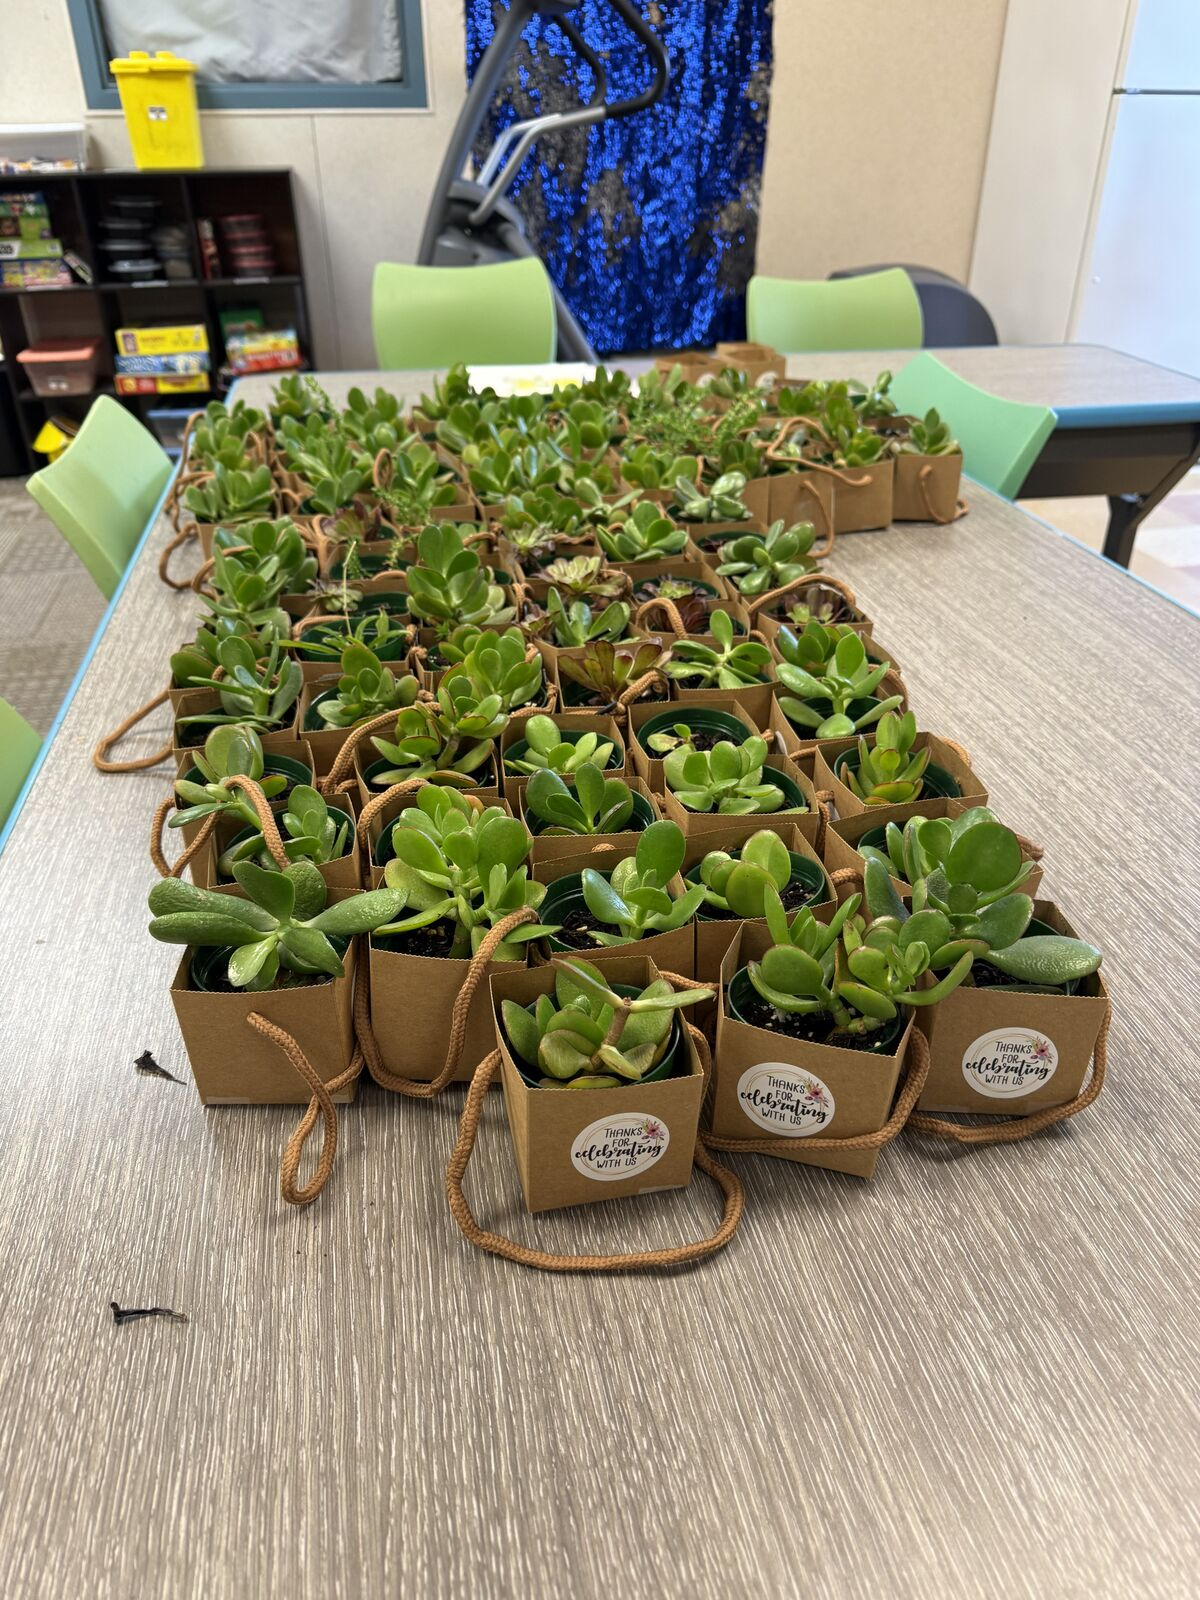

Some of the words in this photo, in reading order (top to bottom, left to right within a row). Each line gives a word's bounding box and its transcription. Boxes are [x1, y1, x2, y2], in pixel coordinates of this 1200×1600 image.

[995, 1041, 1033, 1054] THANKS
[1001, 1053, 1019, 1064] FOR
[965, 1057, 1052, 1080] celebrating
[766, 1075, 806, 1094] THANKS
[985, 1074, 1008, 1085] WITH
[1012, 1076, 1024, 1085] US
[775, 1090, 793, 1101] FOR
[740, 1089, 829, 1123] celebrating
[761, 1107, 785, 1121] WITH
[790, 1116, 802, 1125] US
[604, 1127, 643, 1138] THANKS
[612, 1138, 630, 1147] FOR
[575, 1141, 664, 1161] celebrating
[596, 1159, 621, 1168] WITH
[625, 1157, 637, 1166] US
